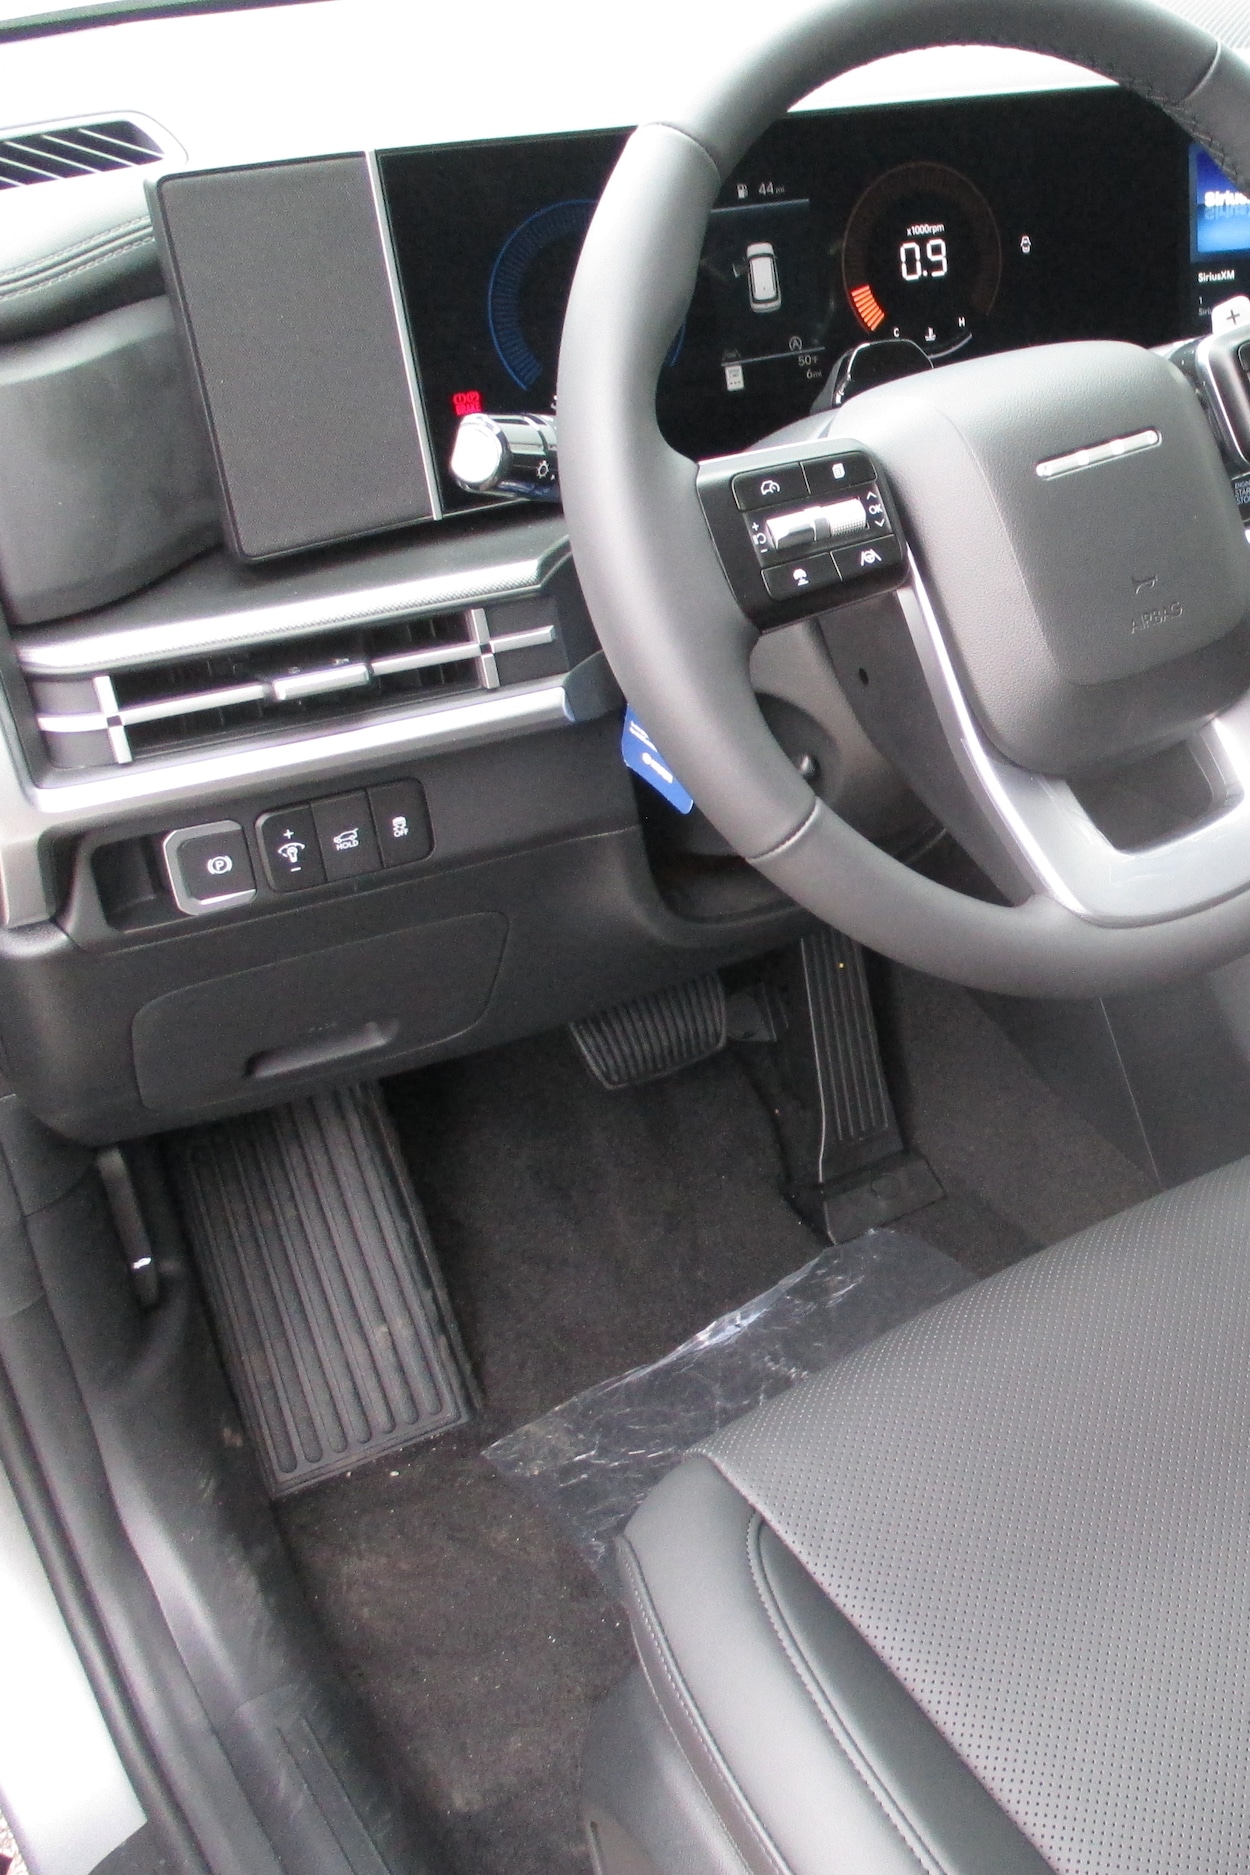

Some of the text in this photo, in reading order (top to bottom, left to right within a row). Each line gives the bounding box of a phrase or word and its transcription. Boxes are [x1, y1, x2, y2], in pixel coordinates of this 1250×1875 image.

[758, 182, 773, 194] 44
[906, 223, 944, 236] x1000rpm
[899, 238, 947, 280] 0.9
[1197, 269, 1234, 282] SiriusXM
[958, 316, 965, 326] H
[893, 327, 899, 337] C
[455, 402, 480, 415] BRAKE
[868, 505, 882, 514] OK
[393, 827, 408, 837] OFF
[335, 839, 358, 850] HOLD
